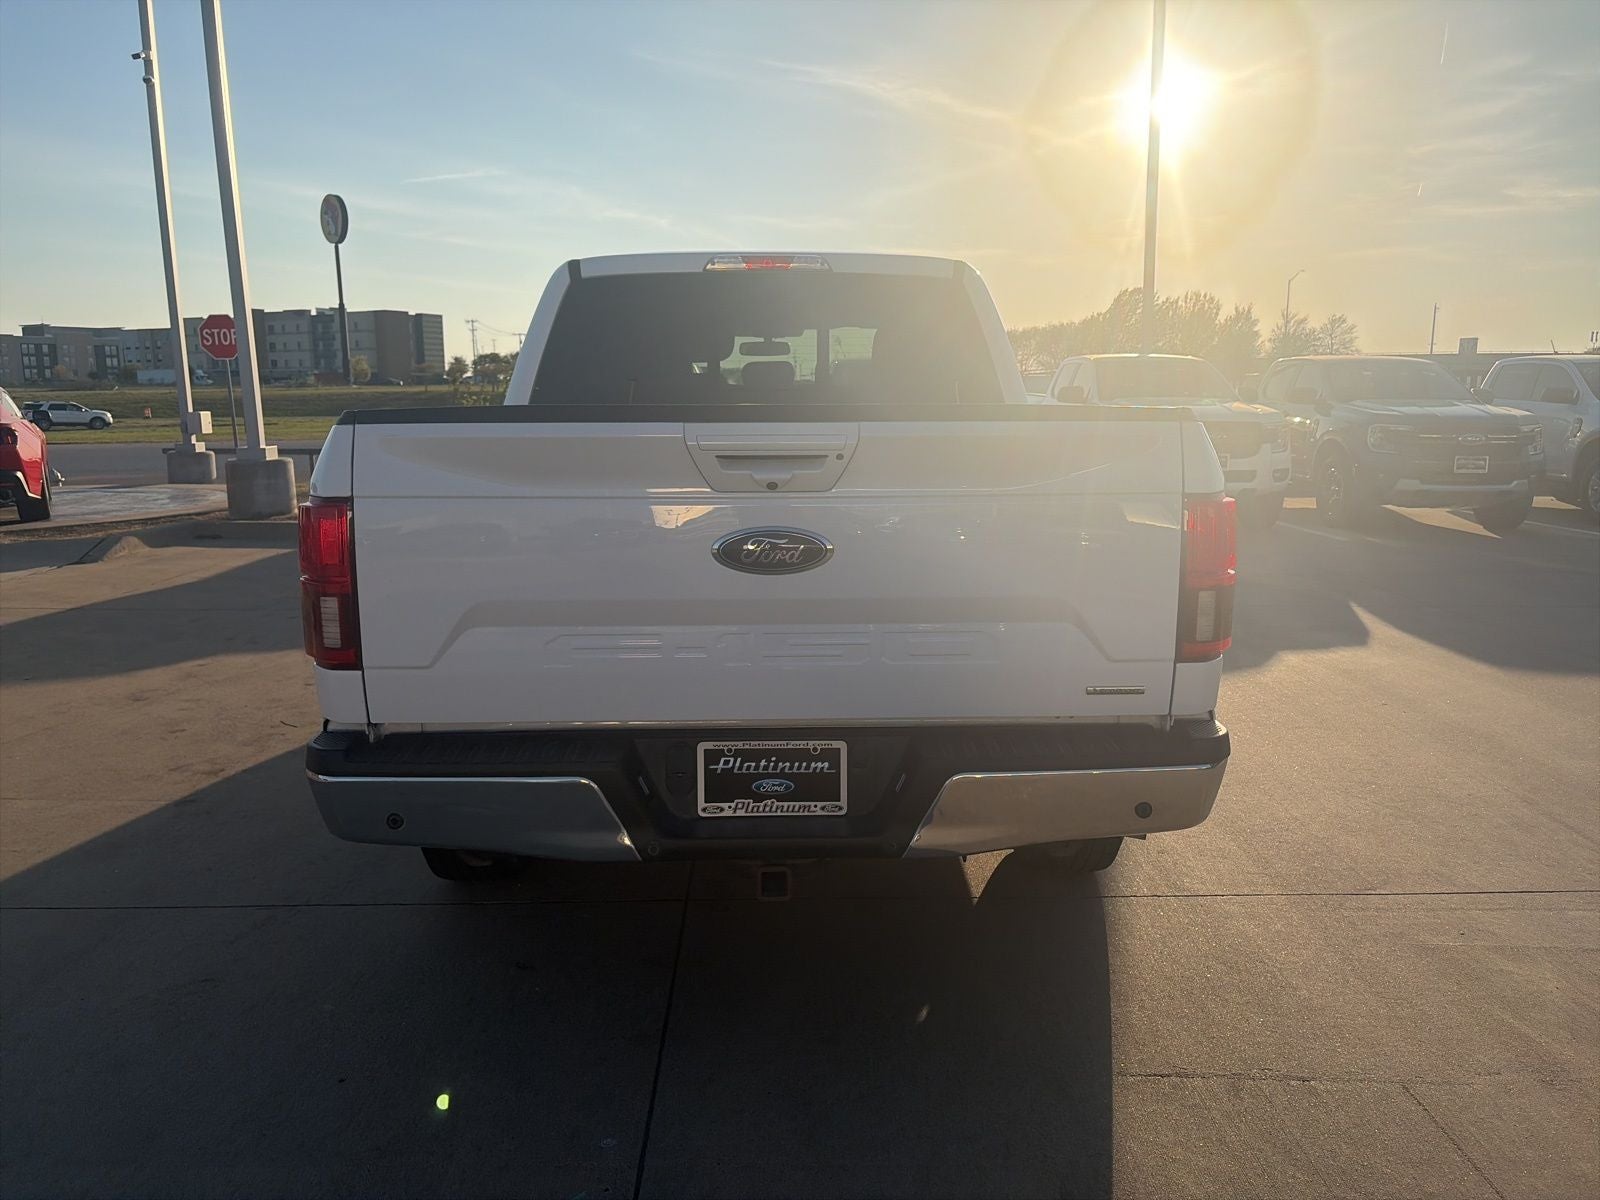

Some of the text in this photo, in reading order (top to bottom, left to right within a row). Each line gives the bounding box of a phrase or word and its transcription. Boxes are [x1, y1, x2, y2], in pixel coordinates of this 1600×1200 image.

[202, 328, 237, 345] STOP
[708, 756, 836, 774] Platinum
[759, 780, 787, 792] Ford
[731, 799, 818, 815] Platinum
